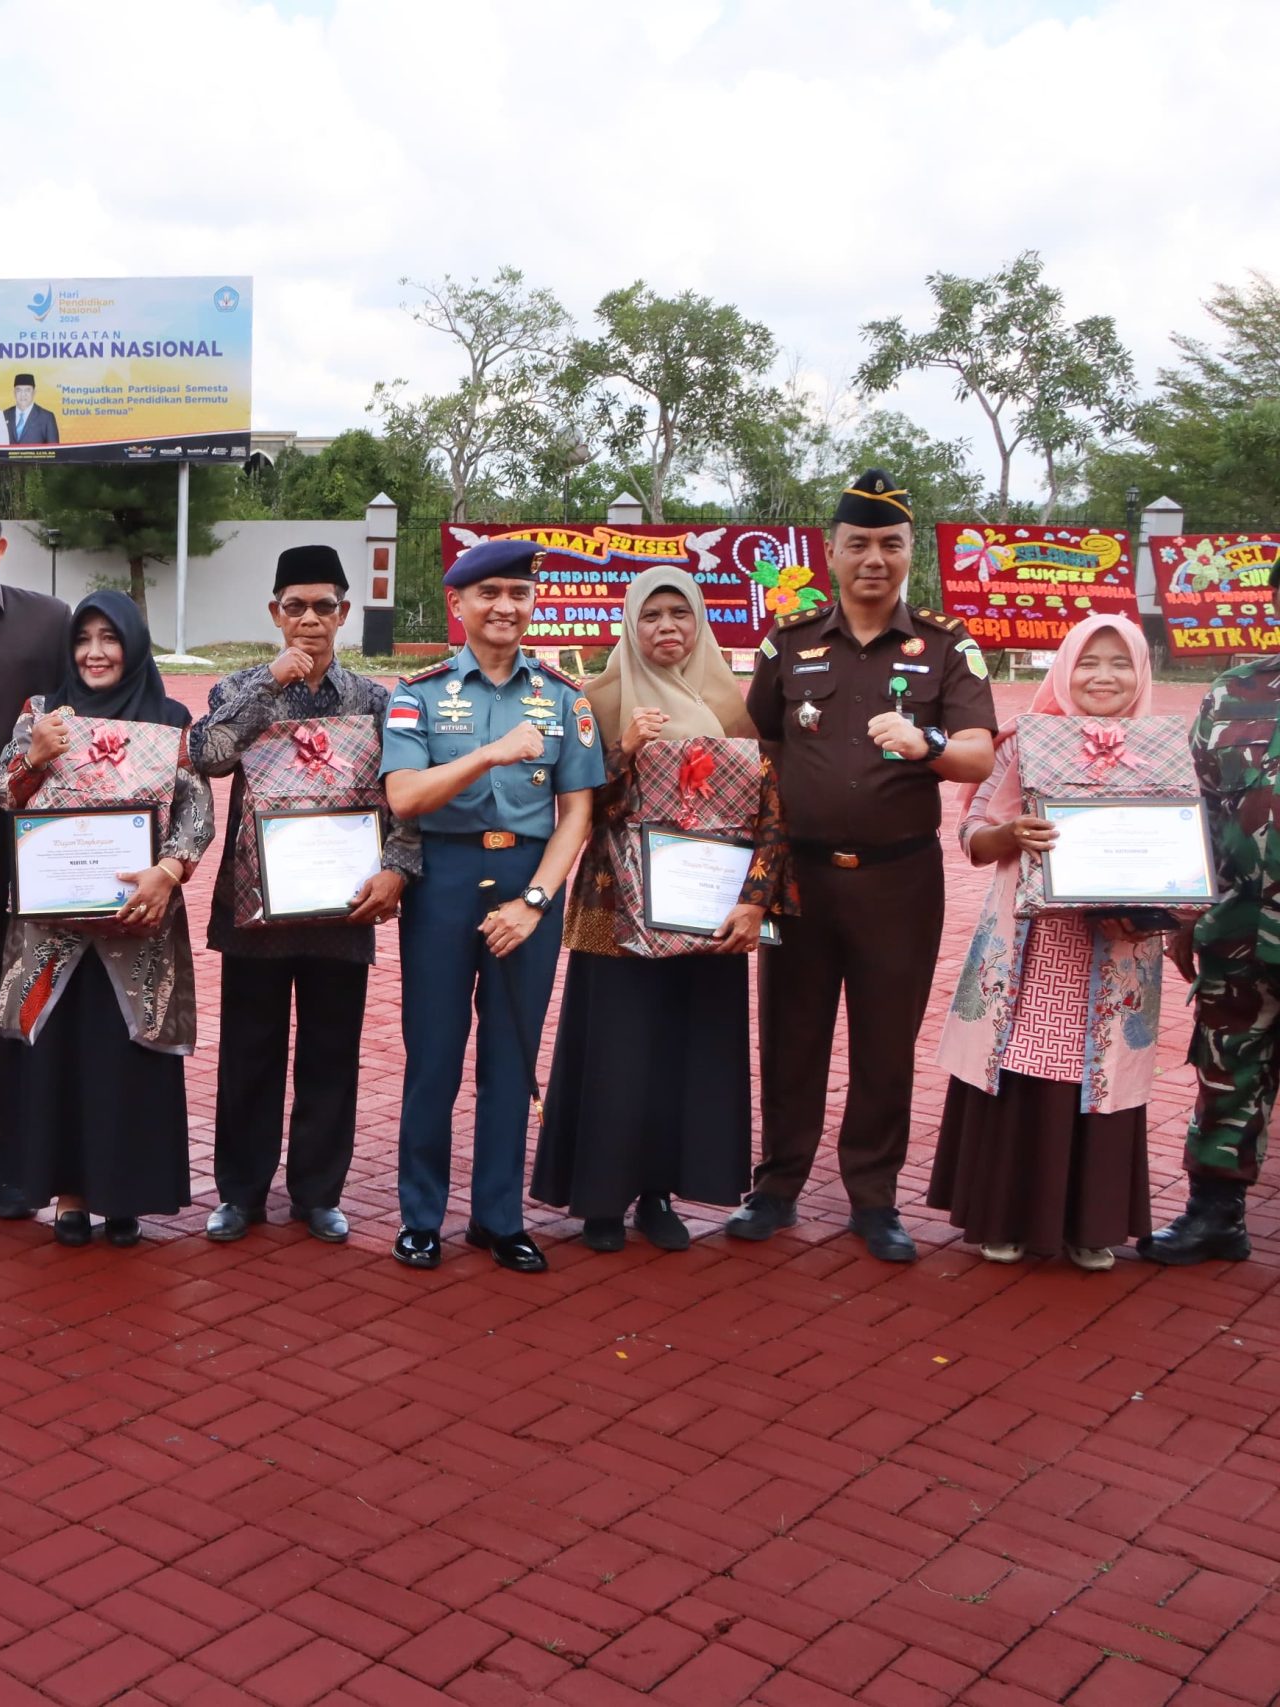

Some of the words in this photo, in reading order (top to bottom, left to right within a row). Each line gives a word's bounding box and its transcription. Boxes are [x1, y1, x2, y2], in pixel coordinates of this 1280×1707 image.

[59, 290, 79, 299] Hari
[59, 299, 114, 307] Pendidikan
[59, 307, 101, 315] Nasional
[19, 331, 121, 340] PERINGATAN
[111, 340, 224, 358] NASIONAL
[128, 384, 180, 394] Partisipasi
[185, 384, 228, 393] Semesta
[62, 396, 124, 406] Mewujudkan
[127, 395, 182, 405] Pendidikan
[185, 395, 228, 404] Bermutu
[62, 407, 91, 416] Untuk
[610, 535, 677, 555] SUKSES
[1015, 545, 1099, 569] SELAMAT
[1016, 567, 1096, 586] SUKSES
[536, 584, 608, 596] TAHUN
[564, 607, 623, 621] DINAS
